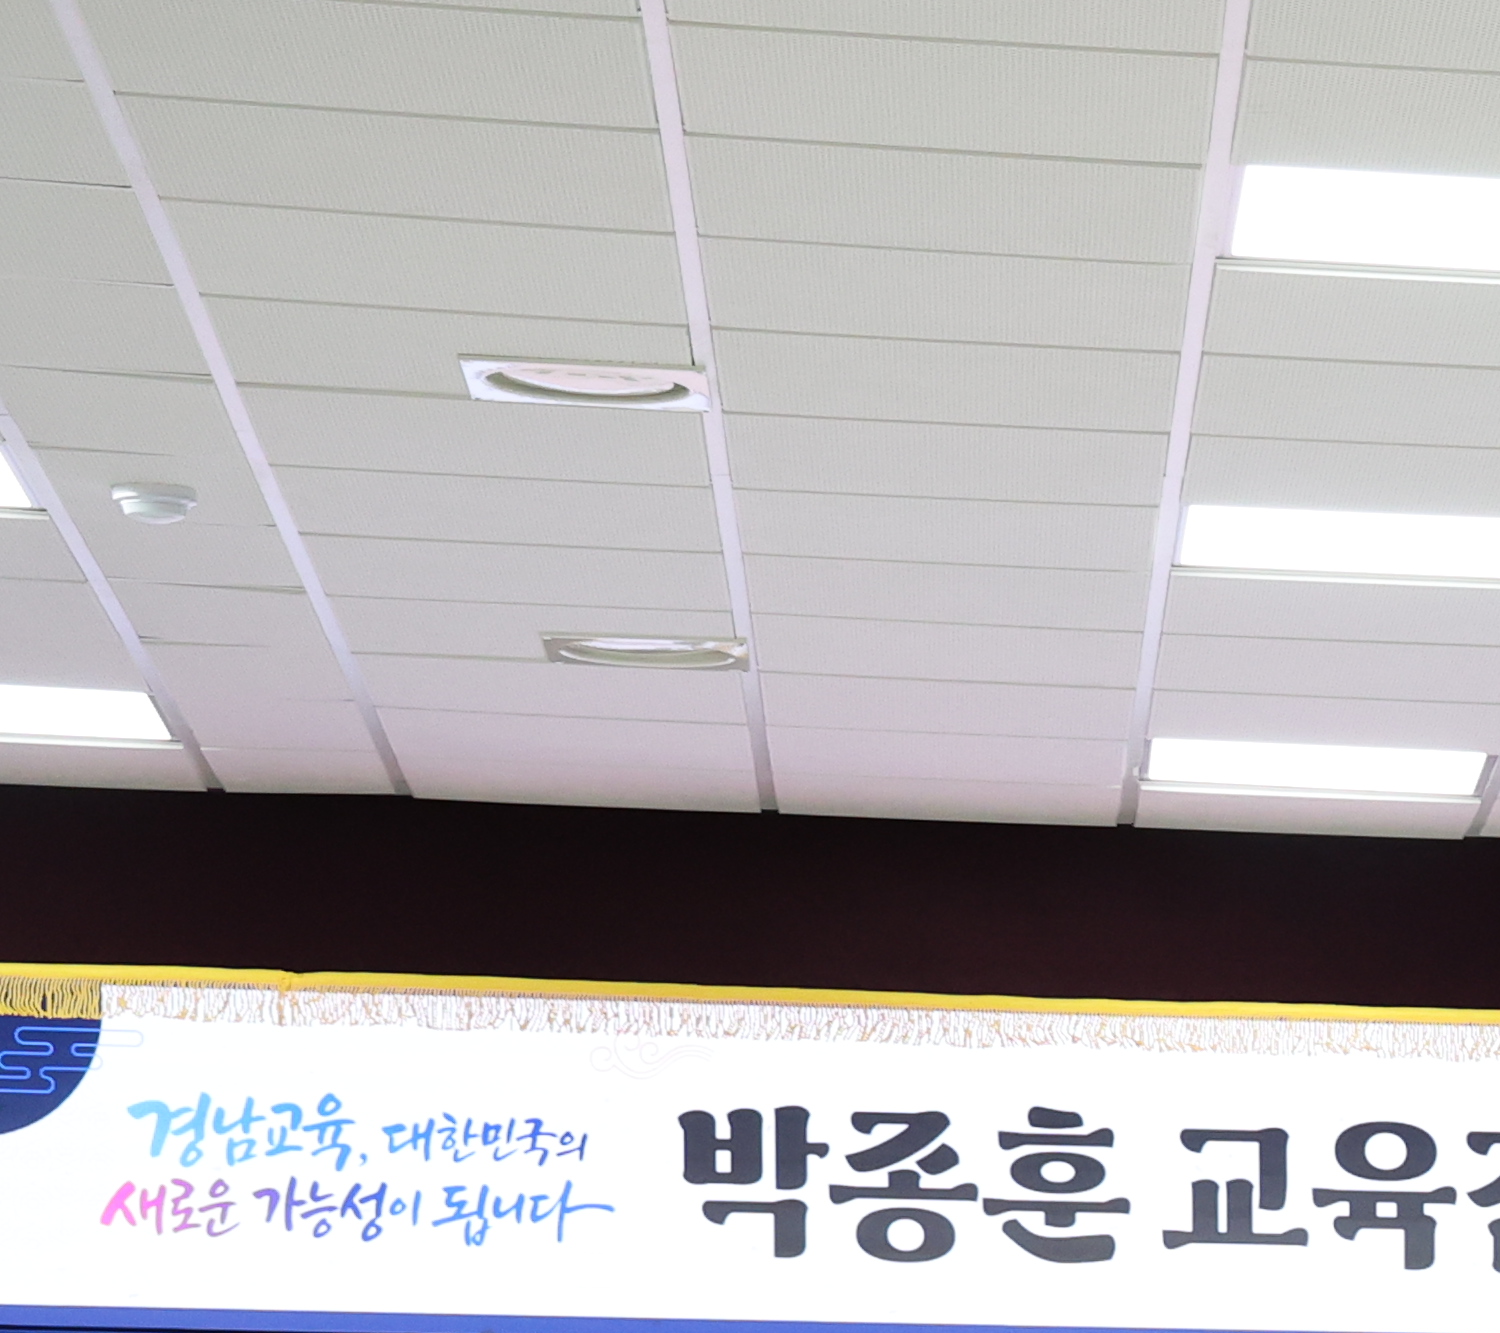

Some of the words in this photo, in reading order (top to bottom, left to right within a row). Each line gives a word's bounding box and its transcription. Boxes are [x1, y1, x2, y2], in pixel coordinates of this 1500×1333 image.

[128, 1093, 367, 1171] 경남교육,
[382, 1113, 588, 1166] 대한민국의
[100, 1178, 241, 1237] 새로운
[253, 1176, 421, 1242] 가능성이
[432, 1181, 614, 1246] 됩니다
[678, 1105, 1131, 1263] 박종훈
